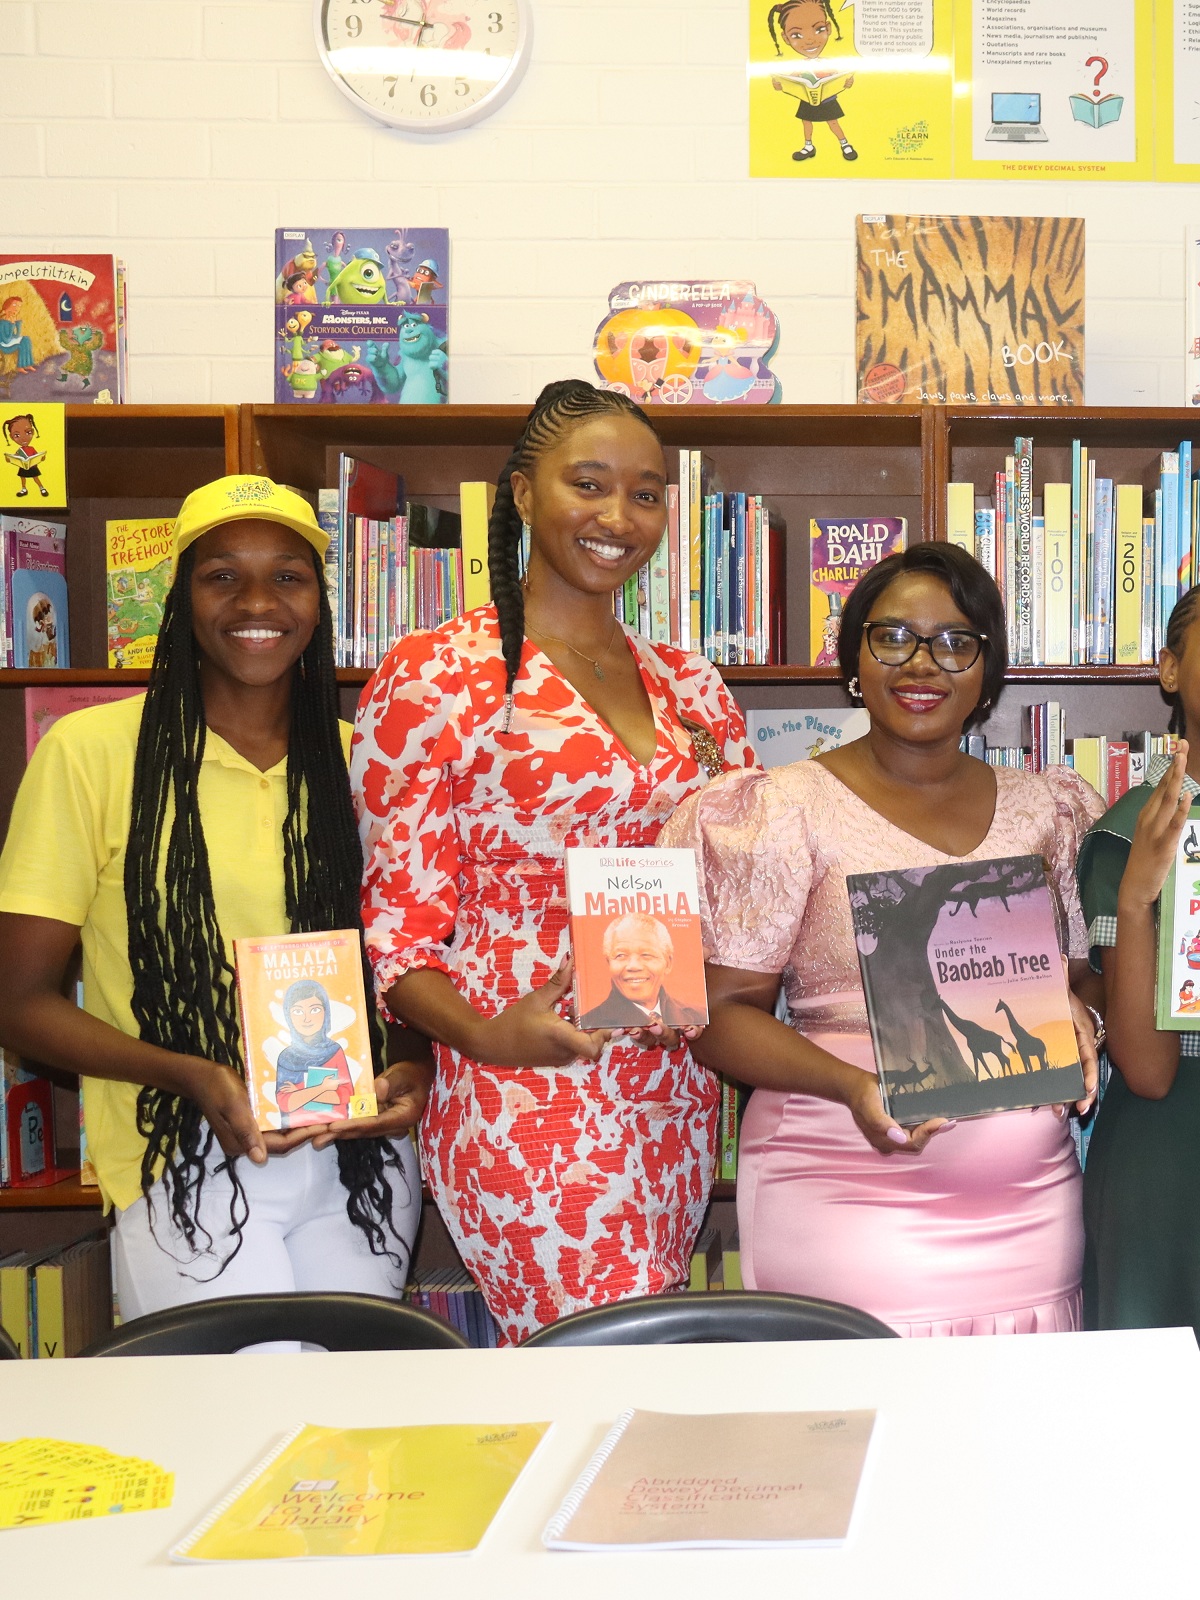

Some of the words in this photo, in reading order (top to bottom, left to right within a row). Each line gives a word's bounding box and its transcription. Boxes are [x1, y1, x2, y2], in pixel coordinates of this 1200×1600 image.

[346, 15, 362, 38] 9
[488, 12, 504, 33] 3
[420, 84, 437, 106] 6
[870, 249, 907, 269] THE
[628, 283, 731, 302] CINDERELLA
[880, 270, 1084, 339] MAMMAL
[322, 314, 370, 325] MONSTERS,
[309, 325, 350, 335] STORYBOOK
[351, 325, 398, 335] COLLECTION
[1000, 340, 1074, 368] BOOK
[916, 390, 947, 402] Jaws,
[949, 392, 978, 404] paws,
[980, 391, 1011, 402] claws
[1014, 392, 1034, 402] and
[1037, 393, 1074, 403] more...
[1021, 457, 1030, 513] GUINNESS
[116, 524, 129, 533] THE
[827, 524, 889, 543] ROALD
[1021, 513, 1030, 556] WORLD
[828, 543, 882, 565] DAHL
[471, 559, 482, 574] D
[812, 567, 859, 582] CHARLIE
[1051, 542, 1063, 592] 100
[1122, 543, 1135, 592] 200
[1021, 556, 1030, 606] RECORDS
[758, 726, 780, 742] Oh,
[782, 720, 802, 732] the
[805, 716, 842, 739] Places
[616, 858, 636, 866] Life
[639, 858, 674, 867] Stories
[607, 875, 662, 890] Nelson
[263, 949, 337, 968] MALALA
[935, 947, 966, 959] Under
[970, 945, 986, 955] the
[266, 964, 338, 980] YOUSAFZAI
[937, 956, 1004, 984] Baobab
[1008, 953, 1050, 975] Tree
[44, 1342, 57, 1358] V
[634, 1477, 738, 1486] Abridged
[713, 1483, 803, 1492] Decimal
[282, 1490, 425, 1504] Welcome
[626, 1492, 779, 1501] Classification
[269, 1505, 300, 1514] to
[313, 1504, 365, 1515] the
[622, 1501, 705, 1511] System
[258, 1515, 380, 1527] Library
